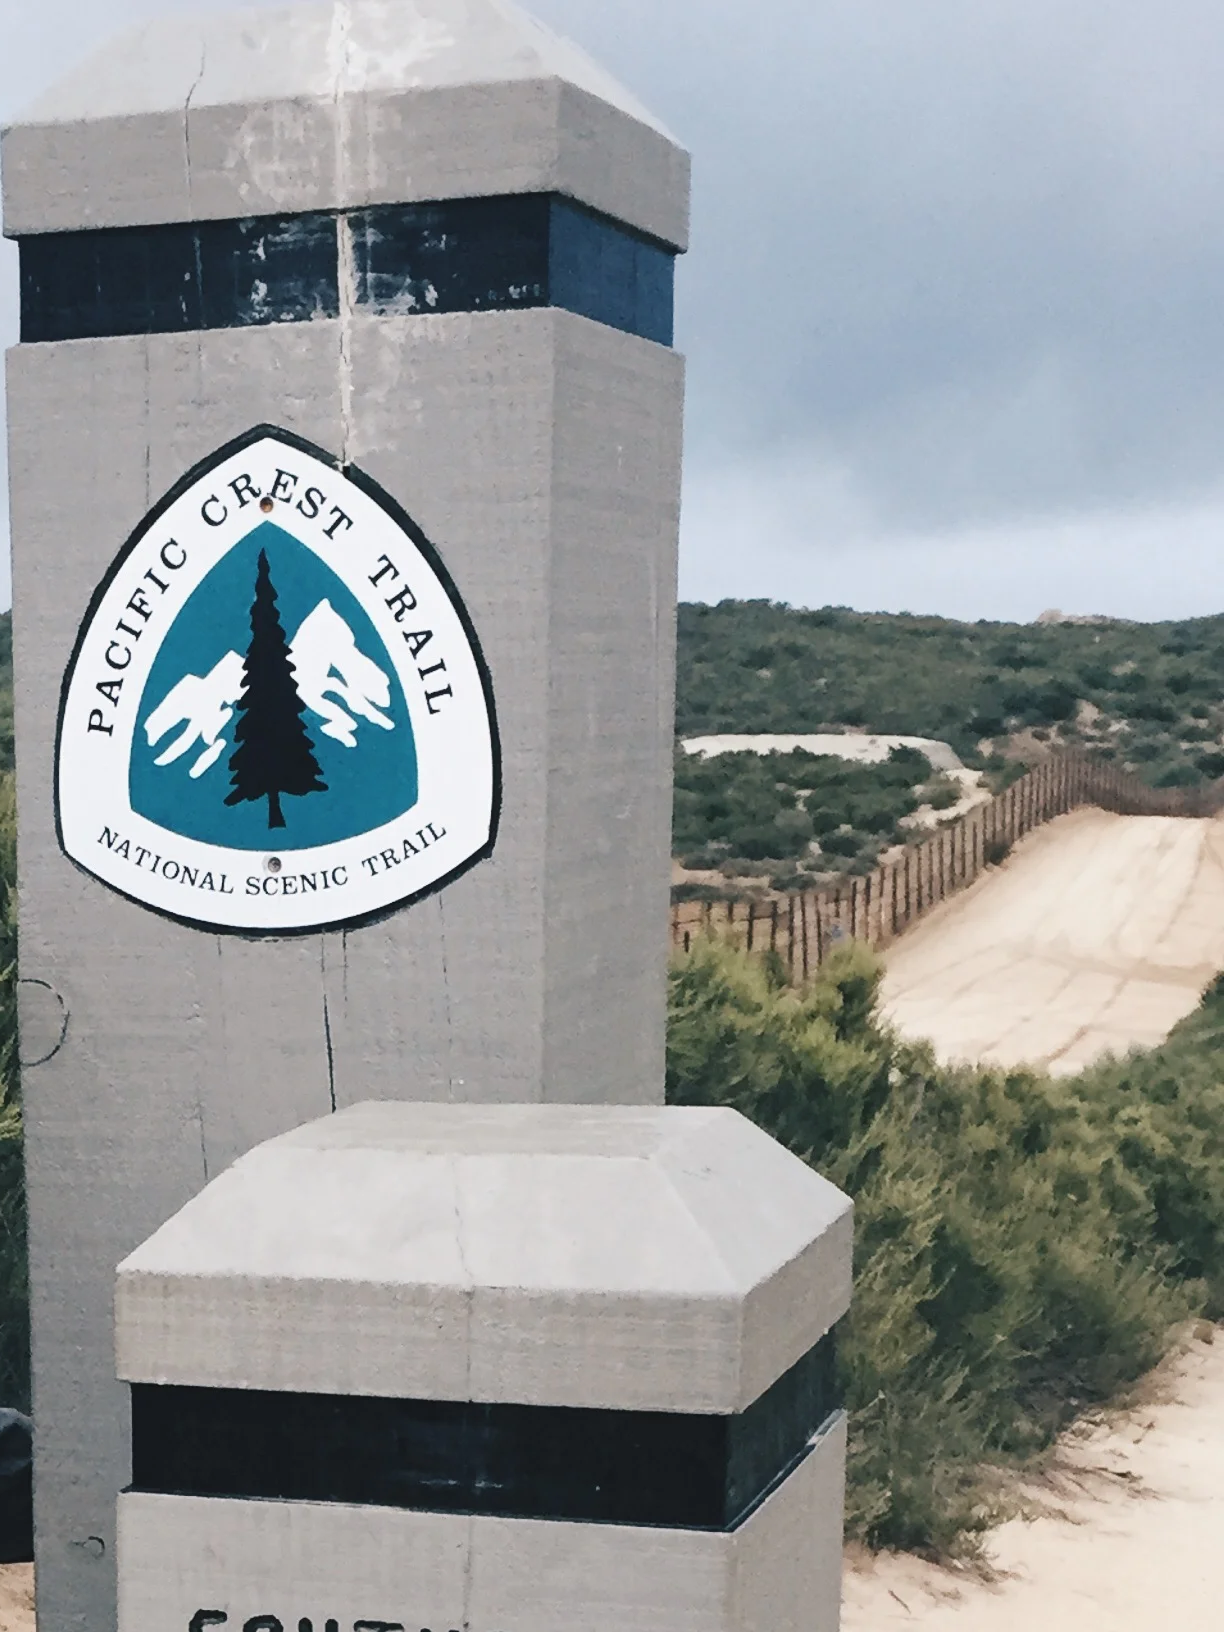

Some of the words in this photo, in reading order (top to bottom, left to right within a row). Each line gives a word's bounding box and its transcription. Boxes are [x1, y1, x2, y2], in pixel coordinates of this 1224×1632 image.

[87, 537, 187, 737] PACIFIC
[201, 468, 354, 540] CREST
[368, 554, 453, 715] TRAIL
[97, 826, 234, 895] NATIONAL
[246, 865, 349, 896] SCENIC
[361, 822, 448, 877] TRAIL
